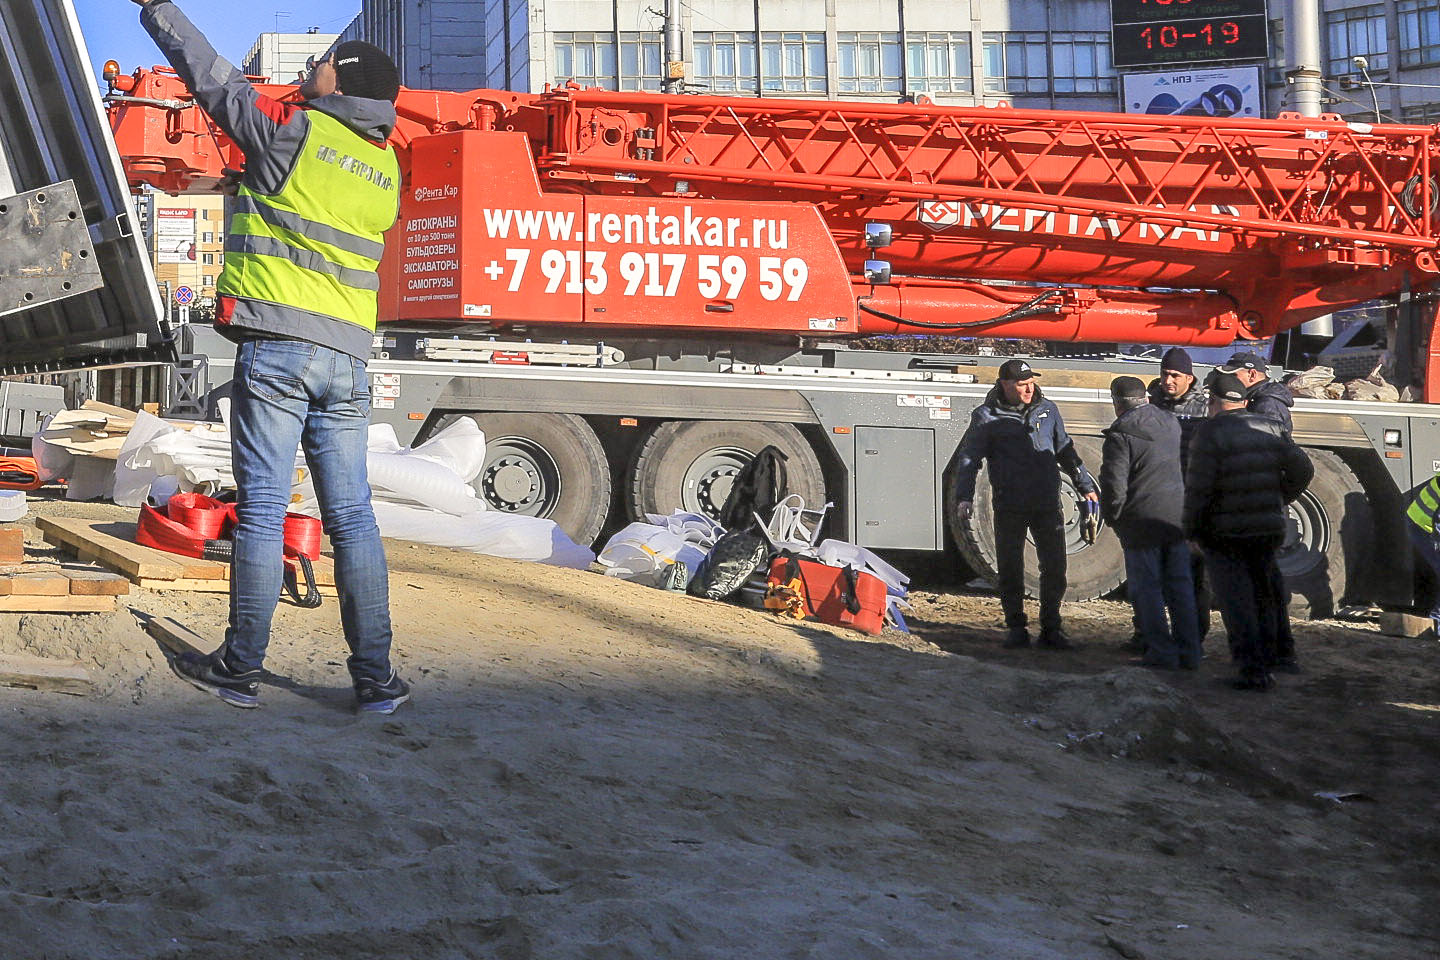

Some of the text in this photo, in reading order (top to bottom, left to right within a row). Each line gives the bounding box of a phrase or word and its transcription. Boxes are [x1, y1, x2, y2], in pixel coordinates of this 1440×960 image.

[1139, 21, 1240, 50] 10-19
[1172, 75, 1192, 84] НПЗ
[422, 186, 443, 199] Рента
[444, 184, 458, 198] Кар
[406, 215, 457, 232] АВТОКРАНЫ
[483, 205, 789, 250] www.rentakar.ru
[429, 231, 441, 241] 500
[441, 232, 455, 240] тонн
[406, 243, 456, 258] БУЛЬДОЗЕРЫ
[403, 259, 459, 274] ЭКСКАВАТОРЫ
[484, 248, 809, 302] +7 913 917 59 59
[408, 276, 454, 290] САМОГРУЗЫ
